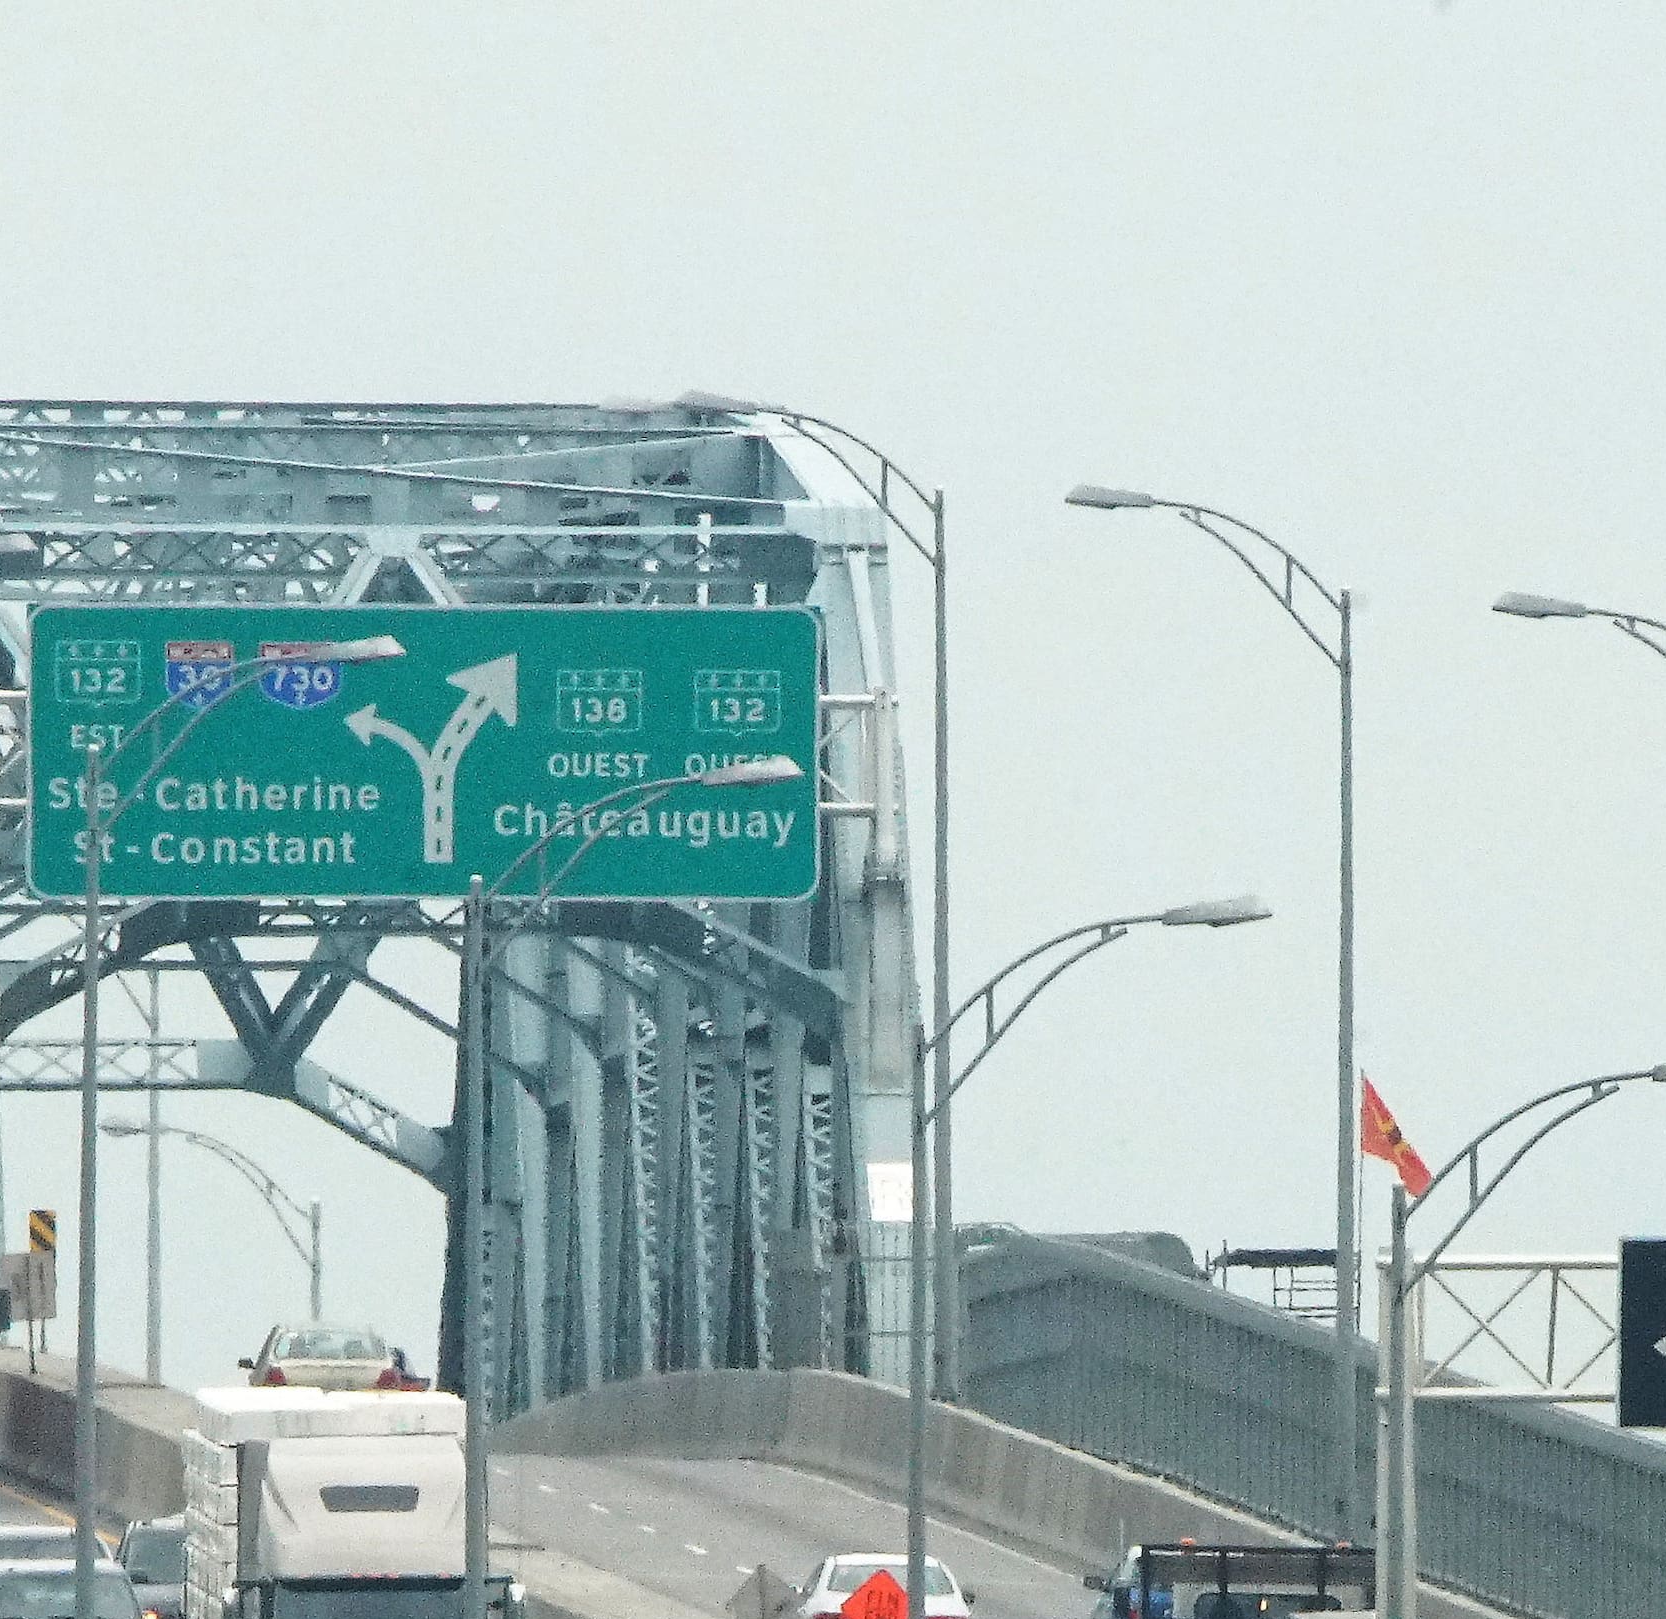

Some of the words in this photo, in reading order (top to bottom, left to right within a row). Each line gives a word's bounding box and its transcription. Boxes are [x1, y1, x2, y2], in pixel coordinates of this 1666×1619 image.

[70, 666, 127, 693] 132
[273, 665, 333, 691] 730
[710, 697, 766, 722] 132
[71, 724, 125, 749] EST
[547, 752, 652, 778] OUEST
[73, 831, 357, 865] St-Constant
